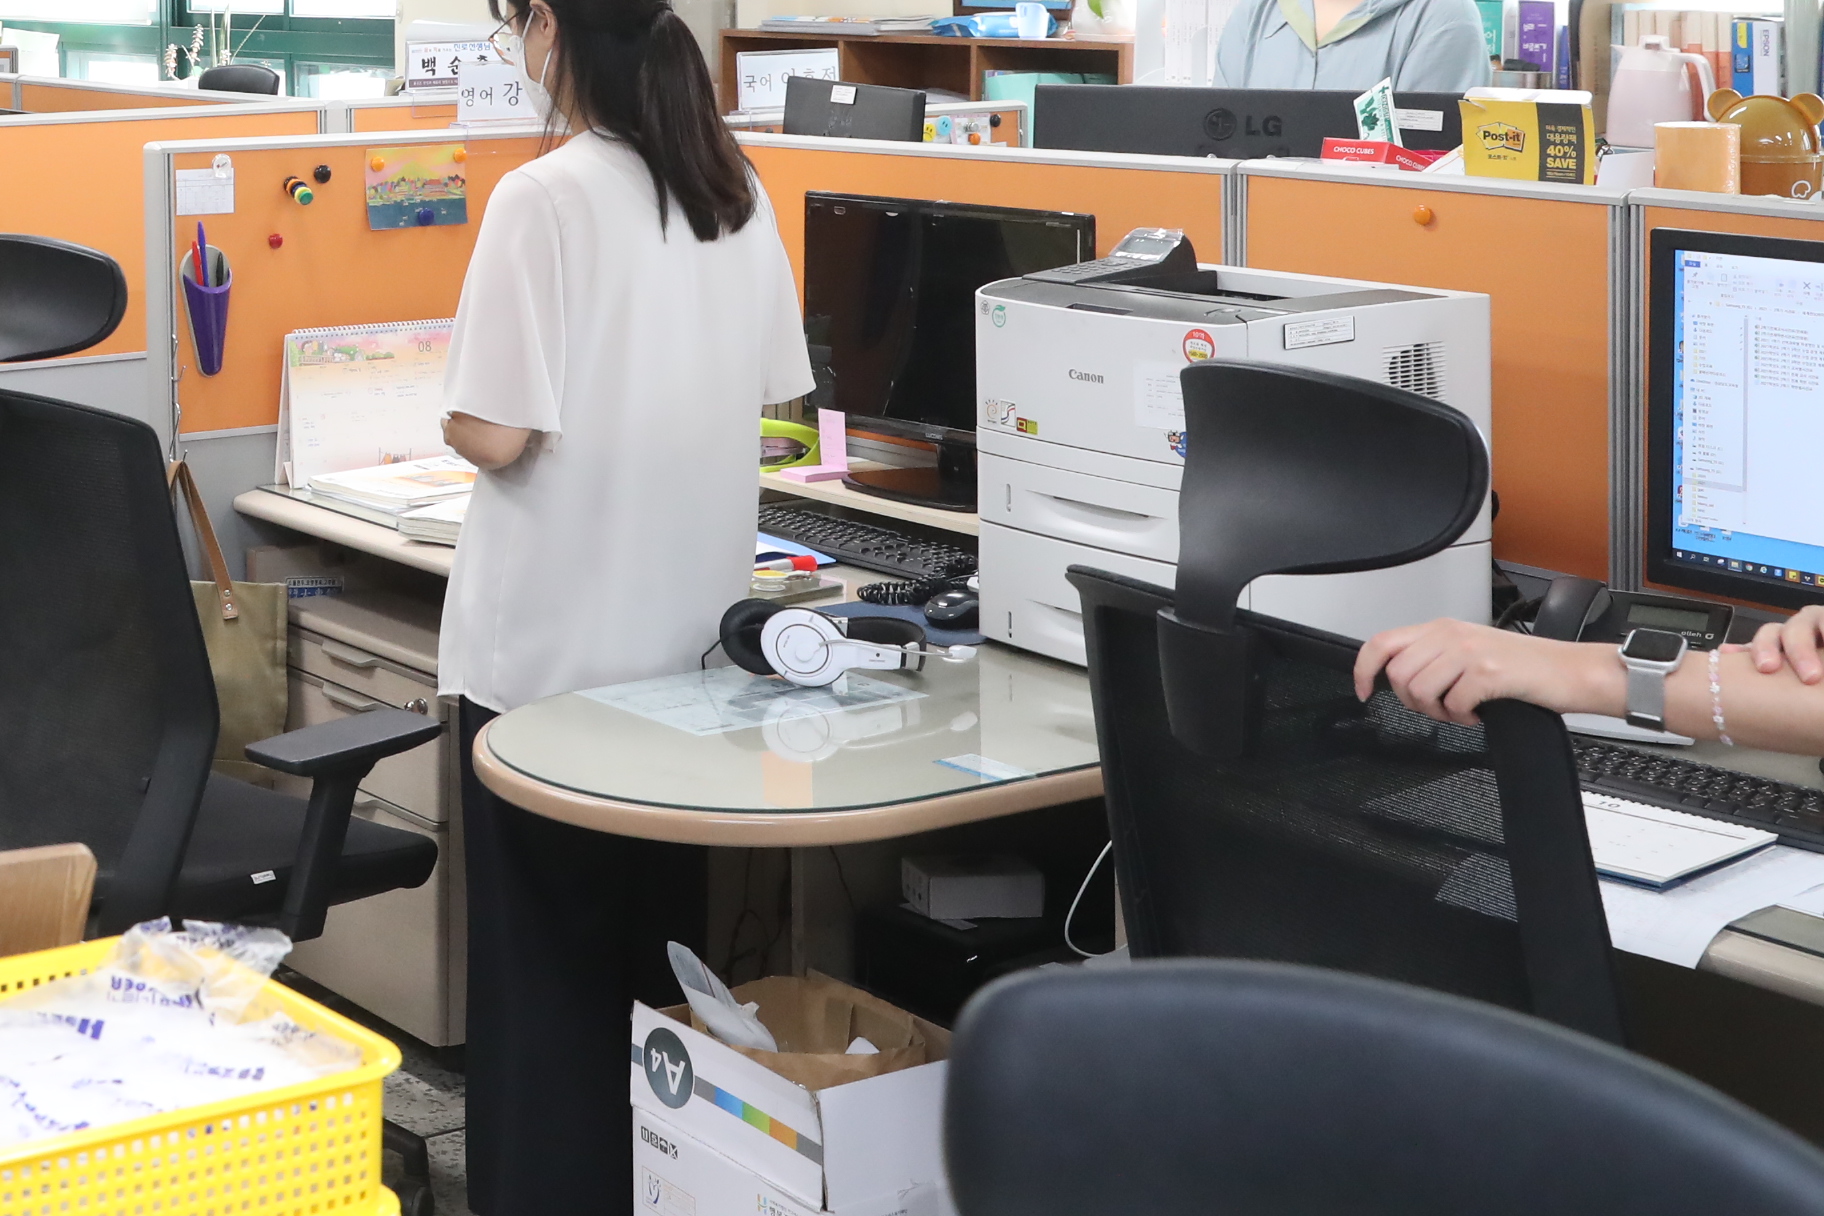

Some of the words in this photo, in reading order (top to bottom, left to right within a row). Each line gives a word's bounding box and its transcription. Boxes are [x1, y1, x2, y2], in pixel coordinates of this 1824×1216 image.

[1762, 29, 1770, 57] EPSON
[743, 73, 773, 93] 국어
[461, 86, 494, 108] 영어
[1245, 115, 1283, 137] LG
[1482, 130, 1521, 142] Post-it
[1546, 132, 1577, 144] 대용량팩
[1333, 145, 1355, 154] CHOCO
[1546, 145, 1577, 158] 40%
[1395, 154, 1413, 167] CHOCO
[1546, 157, 1577, 169] SAVE
[417, 340, 432, 353] 08
[1068, 368, 1104, 385] Canon
[650, 1046, 686, 1096] A4
